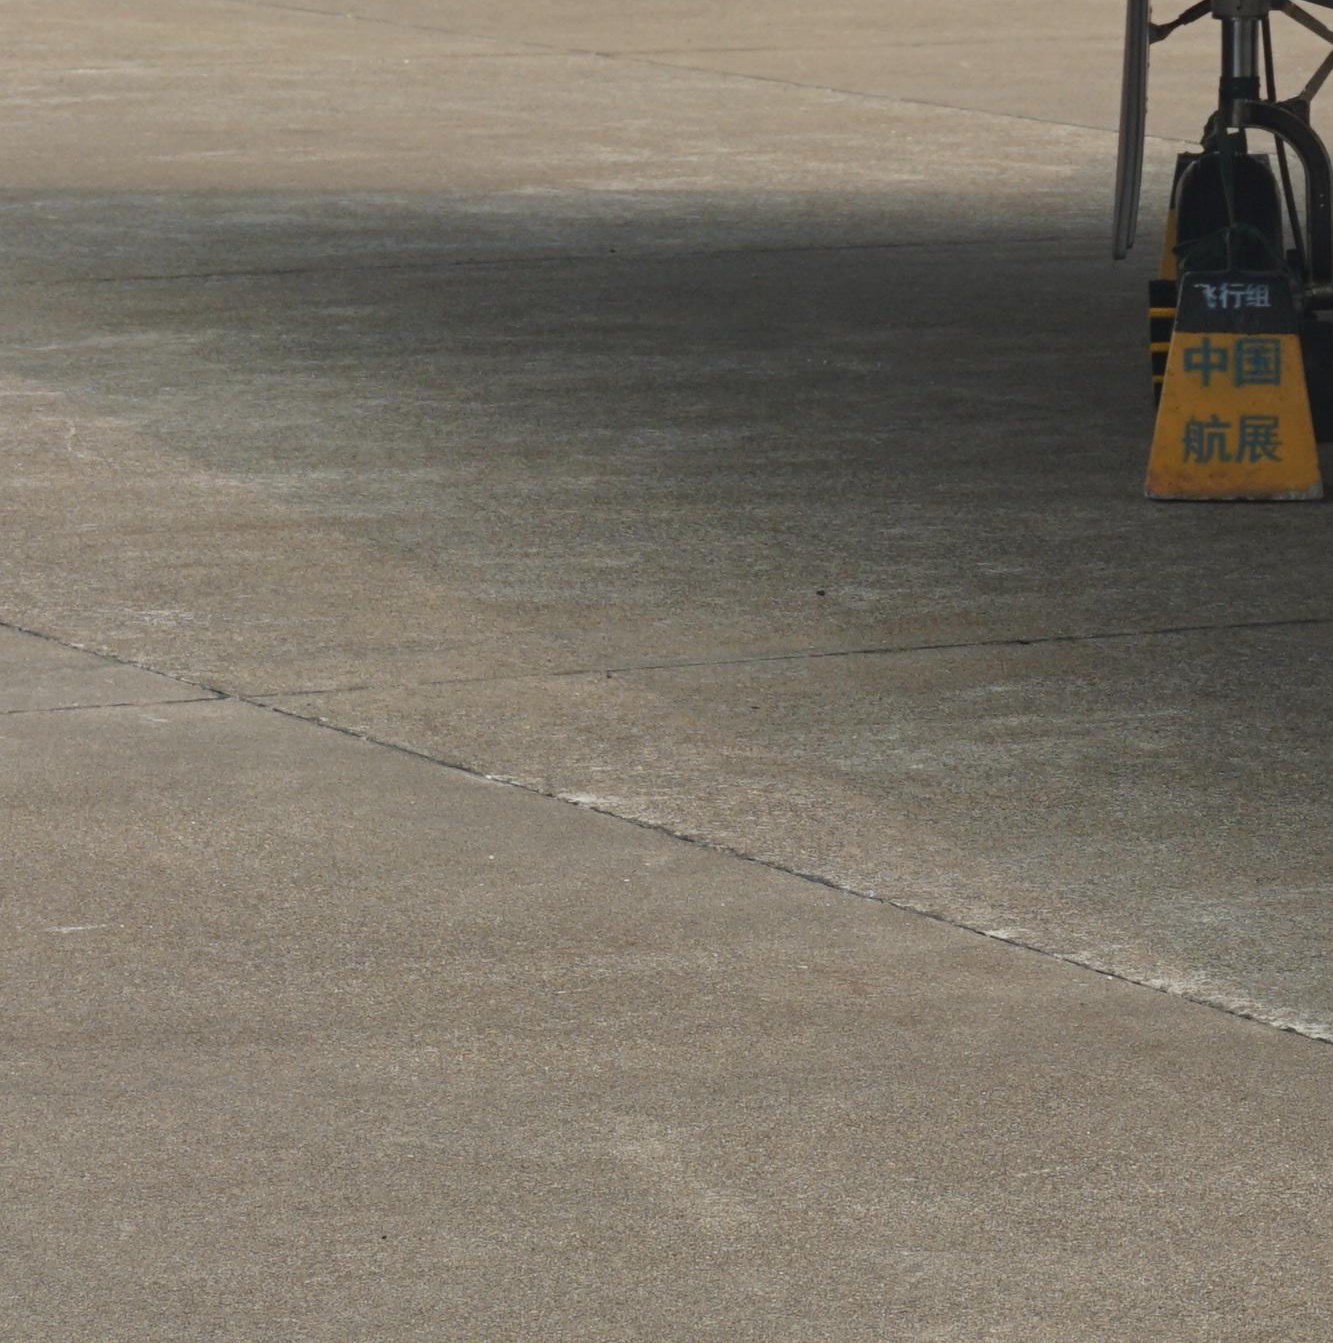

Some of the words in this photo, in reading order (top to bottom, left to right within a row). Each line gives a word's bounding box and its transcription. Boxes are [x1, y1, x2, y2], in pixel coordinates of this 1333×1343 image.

[1194, 282, 1271, 309] 飞行组
[1183, 337, 1283, 388] 中国
[1182, 414, 1283, 465] 航展
